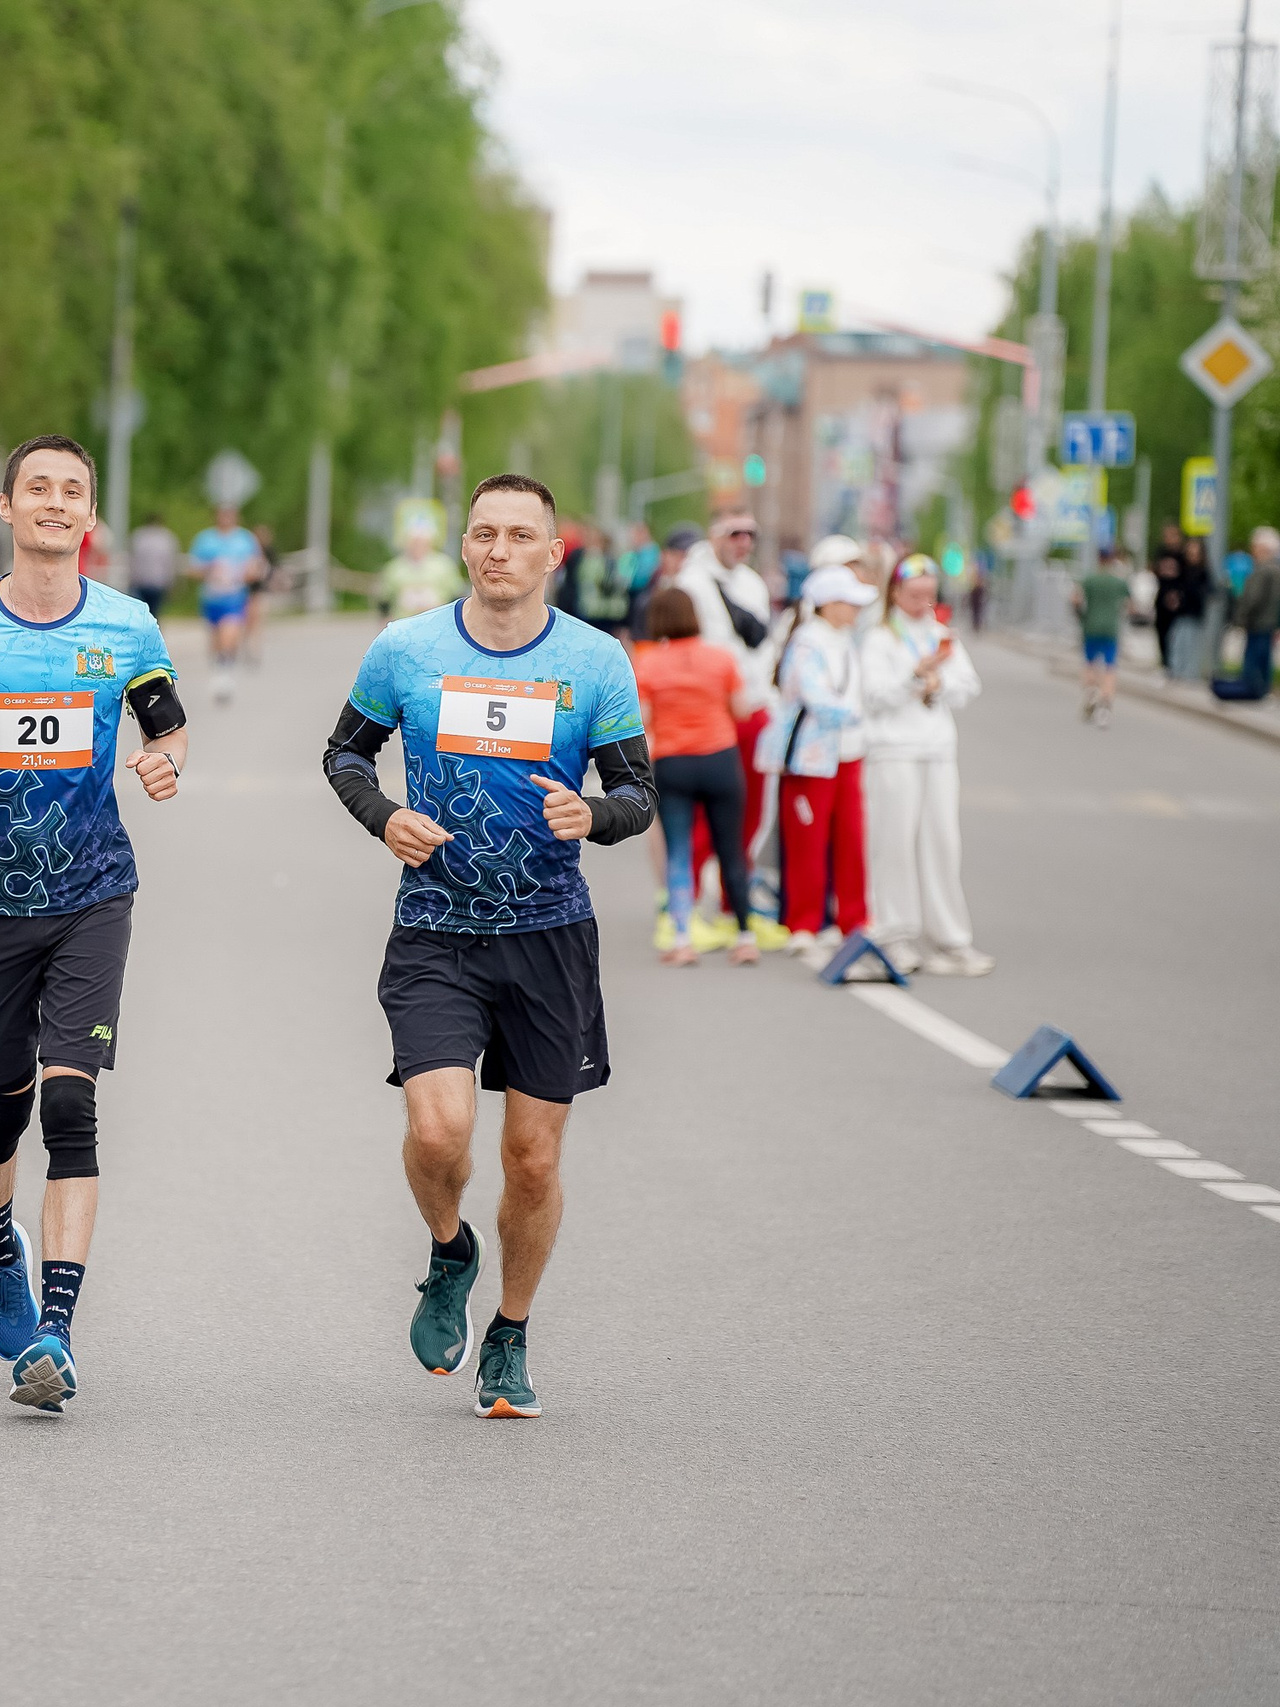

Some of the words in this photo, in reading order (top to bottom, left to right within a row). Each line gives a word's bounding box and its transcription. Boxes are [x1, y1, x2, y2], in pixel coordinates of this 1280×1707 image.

[486, 701, 508, 732] 5
[17, 715, 60, 745] 20
[51, 1267, 79, 1277] FILA
[49, 1286, 75, 1297] FILA
[45, 1305, 68, 1317] FILA
